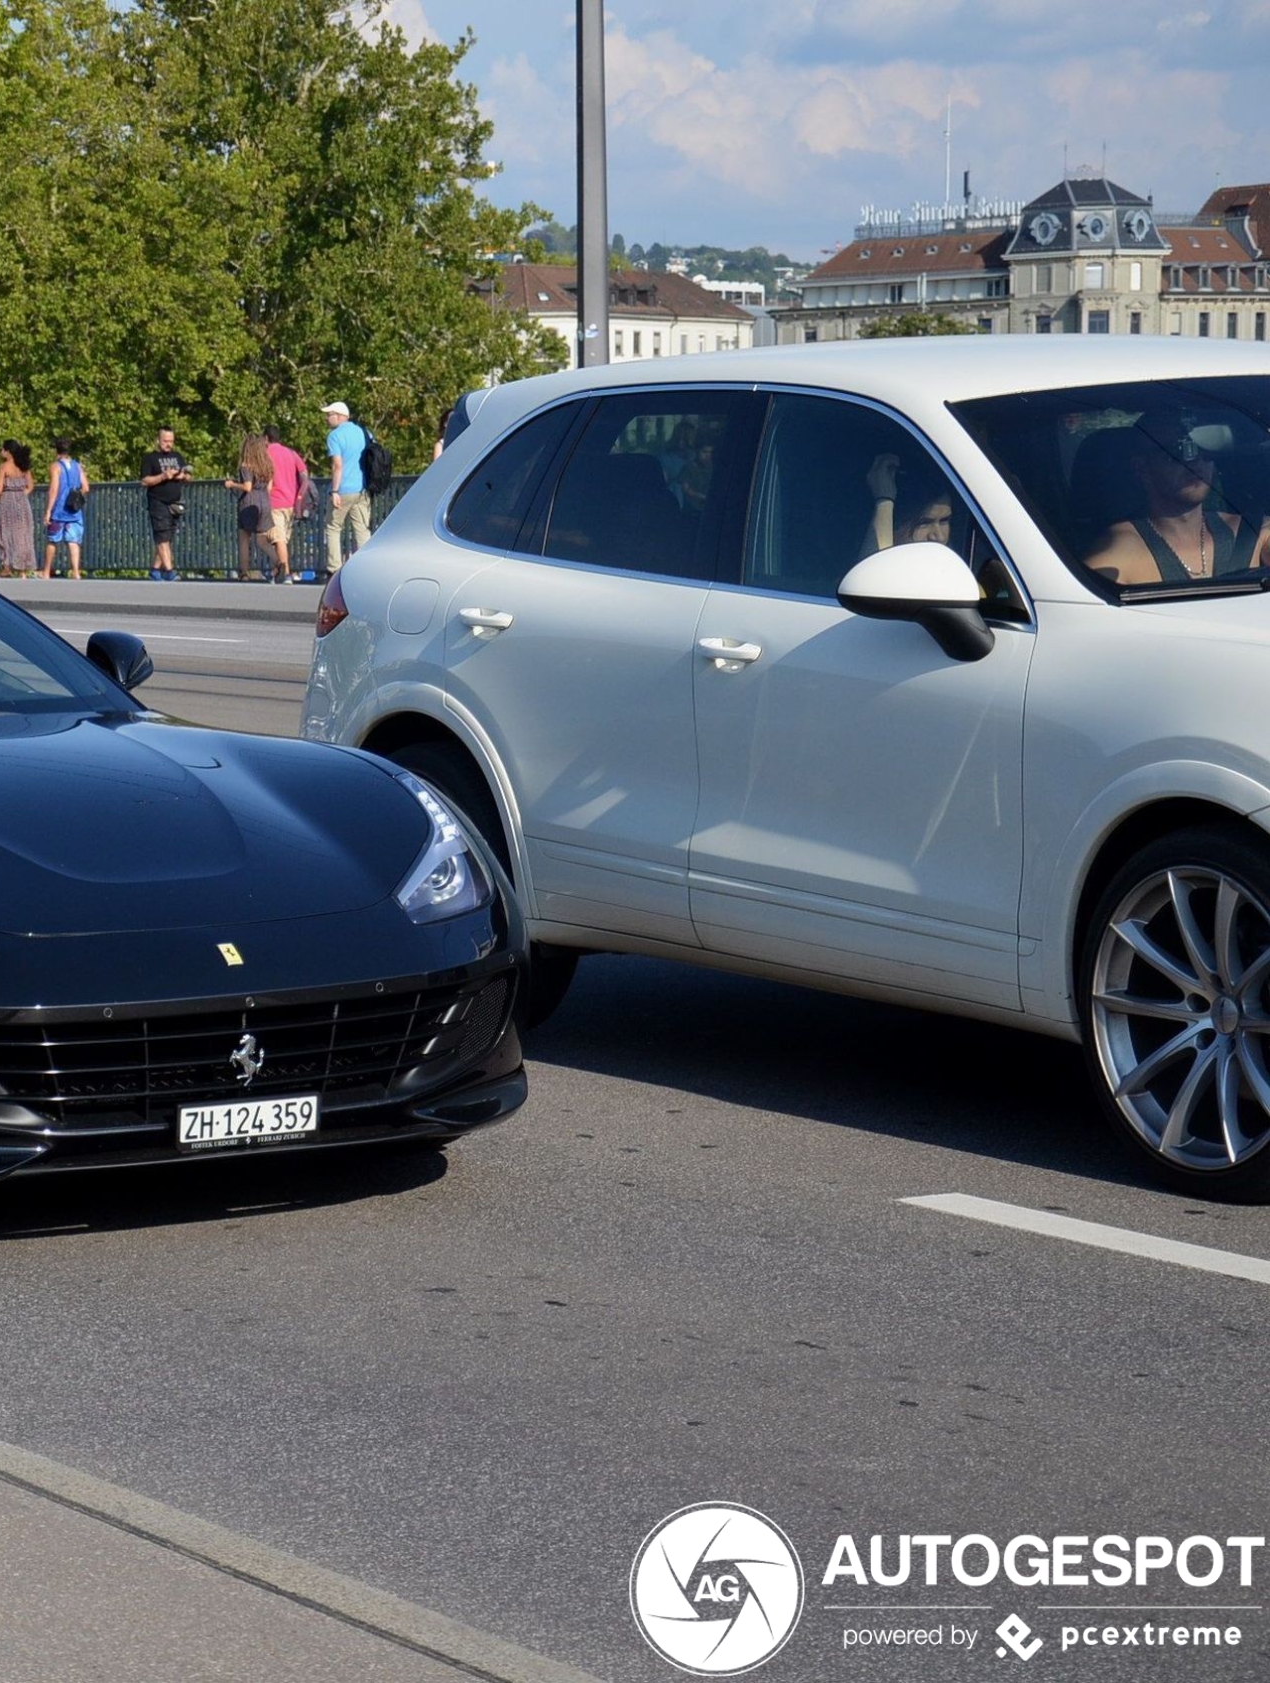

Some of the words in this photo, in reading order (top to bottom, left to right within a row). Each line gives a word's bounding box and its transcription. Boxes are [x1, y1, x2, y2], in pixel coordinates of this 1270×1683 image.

[859, 204, 901, 226] Neue
[905, 200, 968, 223] Zürcher
[973, 197, 1026, 218] Zeitun
